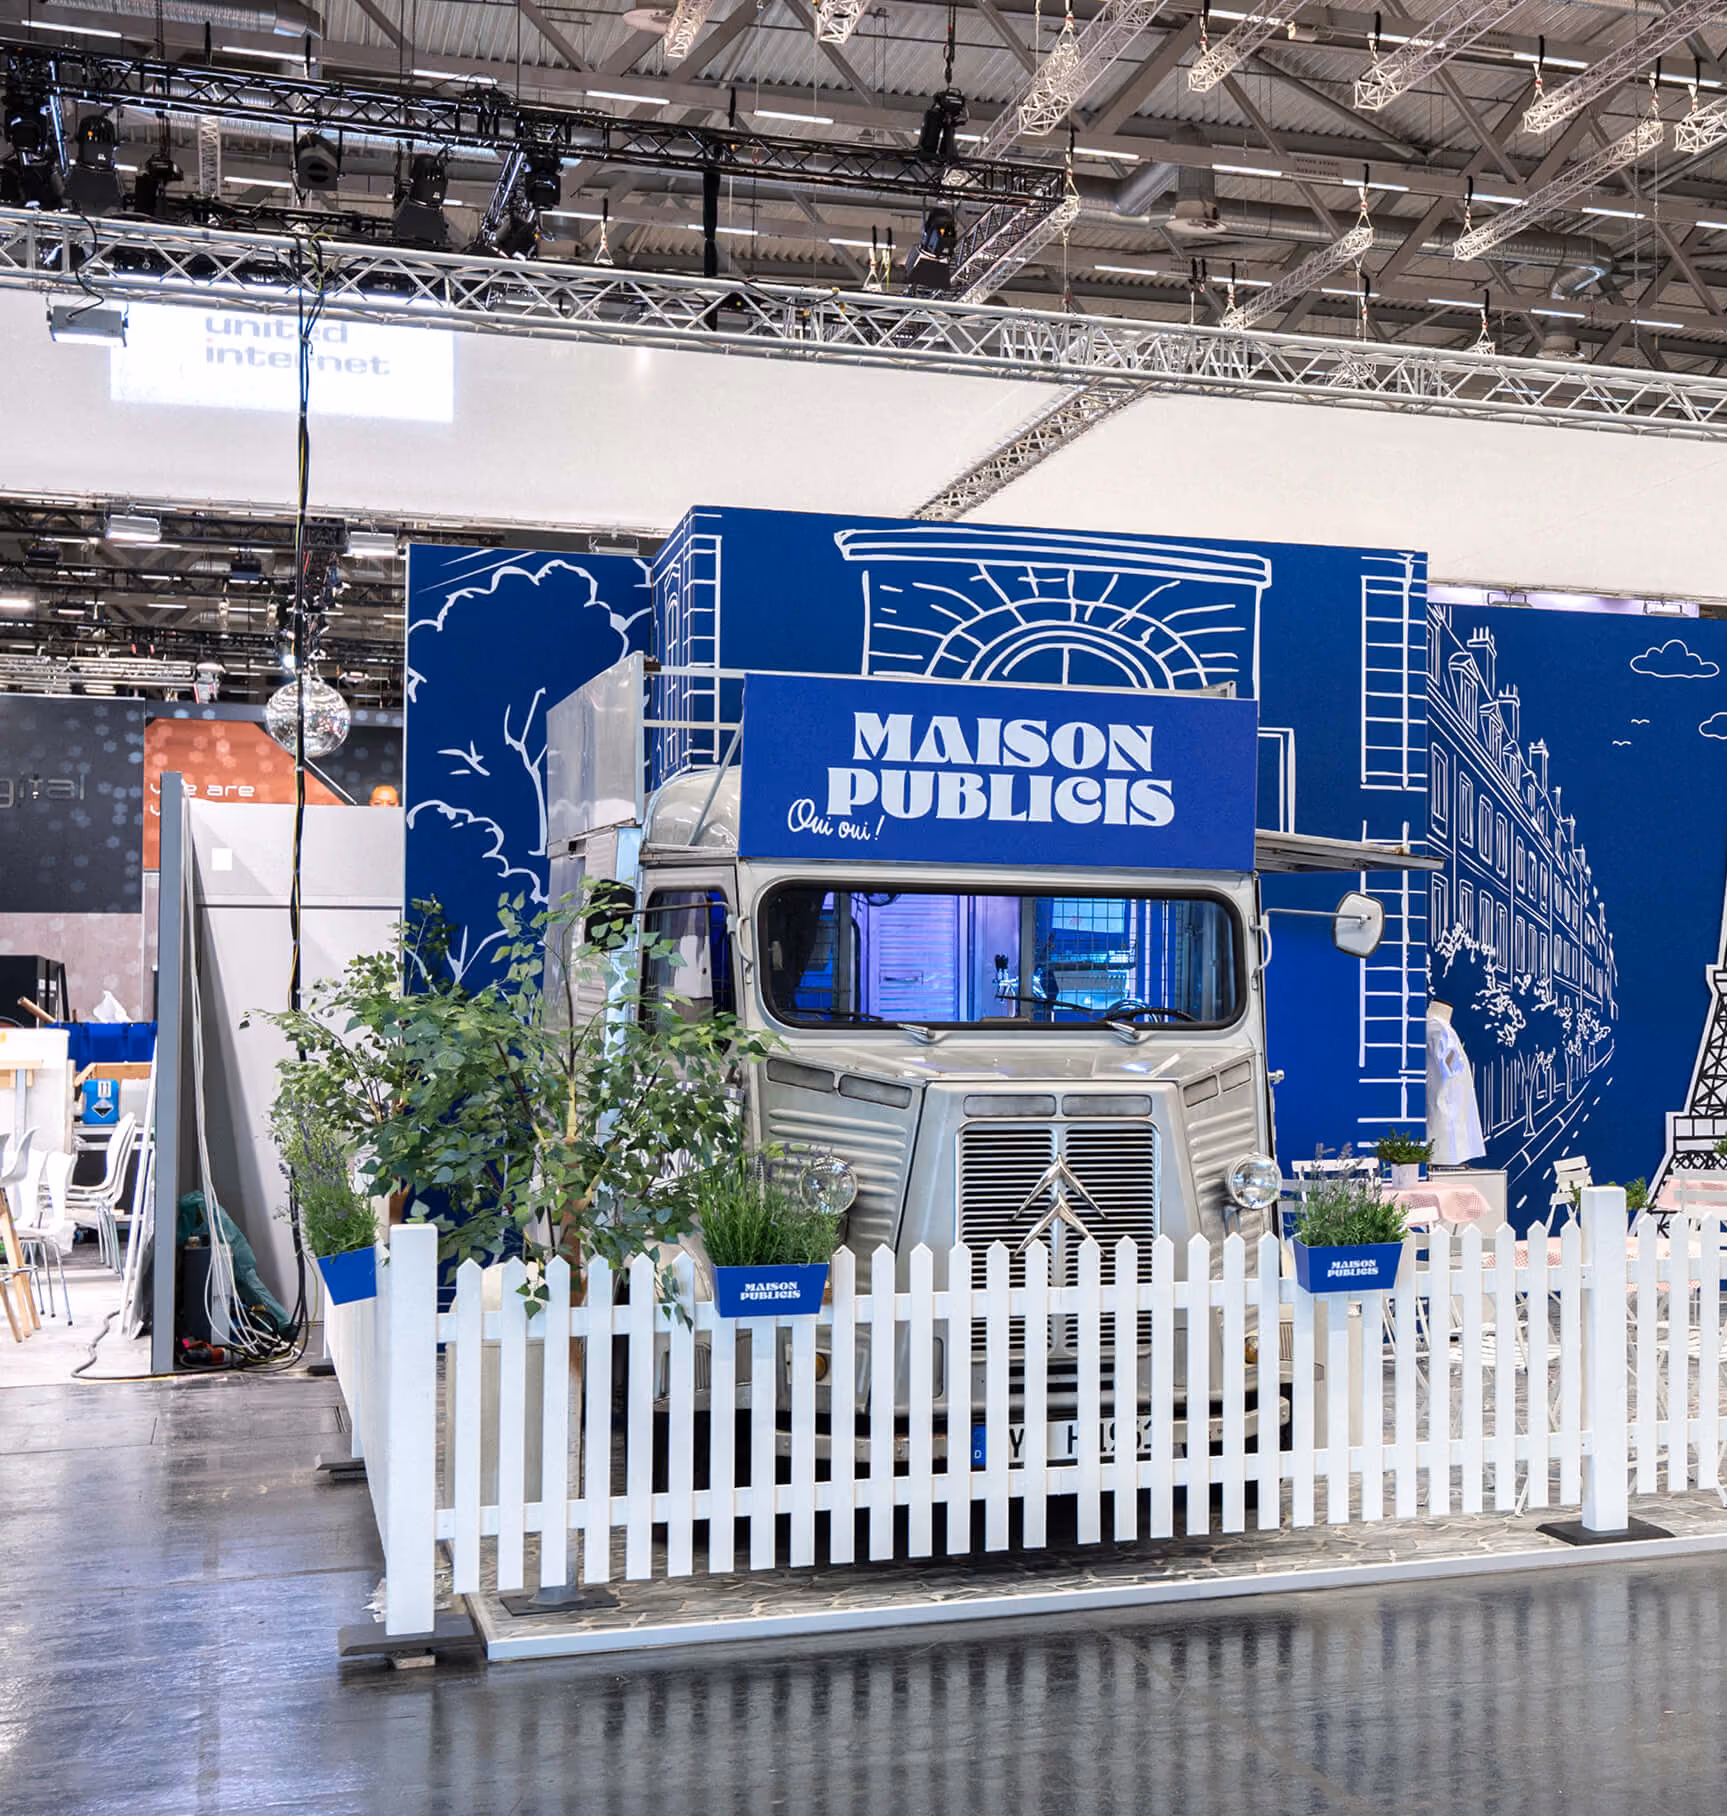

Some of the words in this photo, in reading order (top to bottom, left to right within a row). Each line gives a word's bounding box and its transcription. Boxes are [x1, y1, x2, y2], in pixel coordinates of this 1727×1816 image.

[853, 711, 1154, 772] MAISON
[206, 783, 256, 797] are
[826, 767, 1175, 827] PUBLICIS
[786, 798, 834, 837] Oui
[1330, 1259, 1377, 1269] MAISON
[1327, 1267, 1379, 1278] PUBLICIS
[744, 1281, 798, 1292] MAISON
[740, 1290, 801, 1301] PUBLICIS
